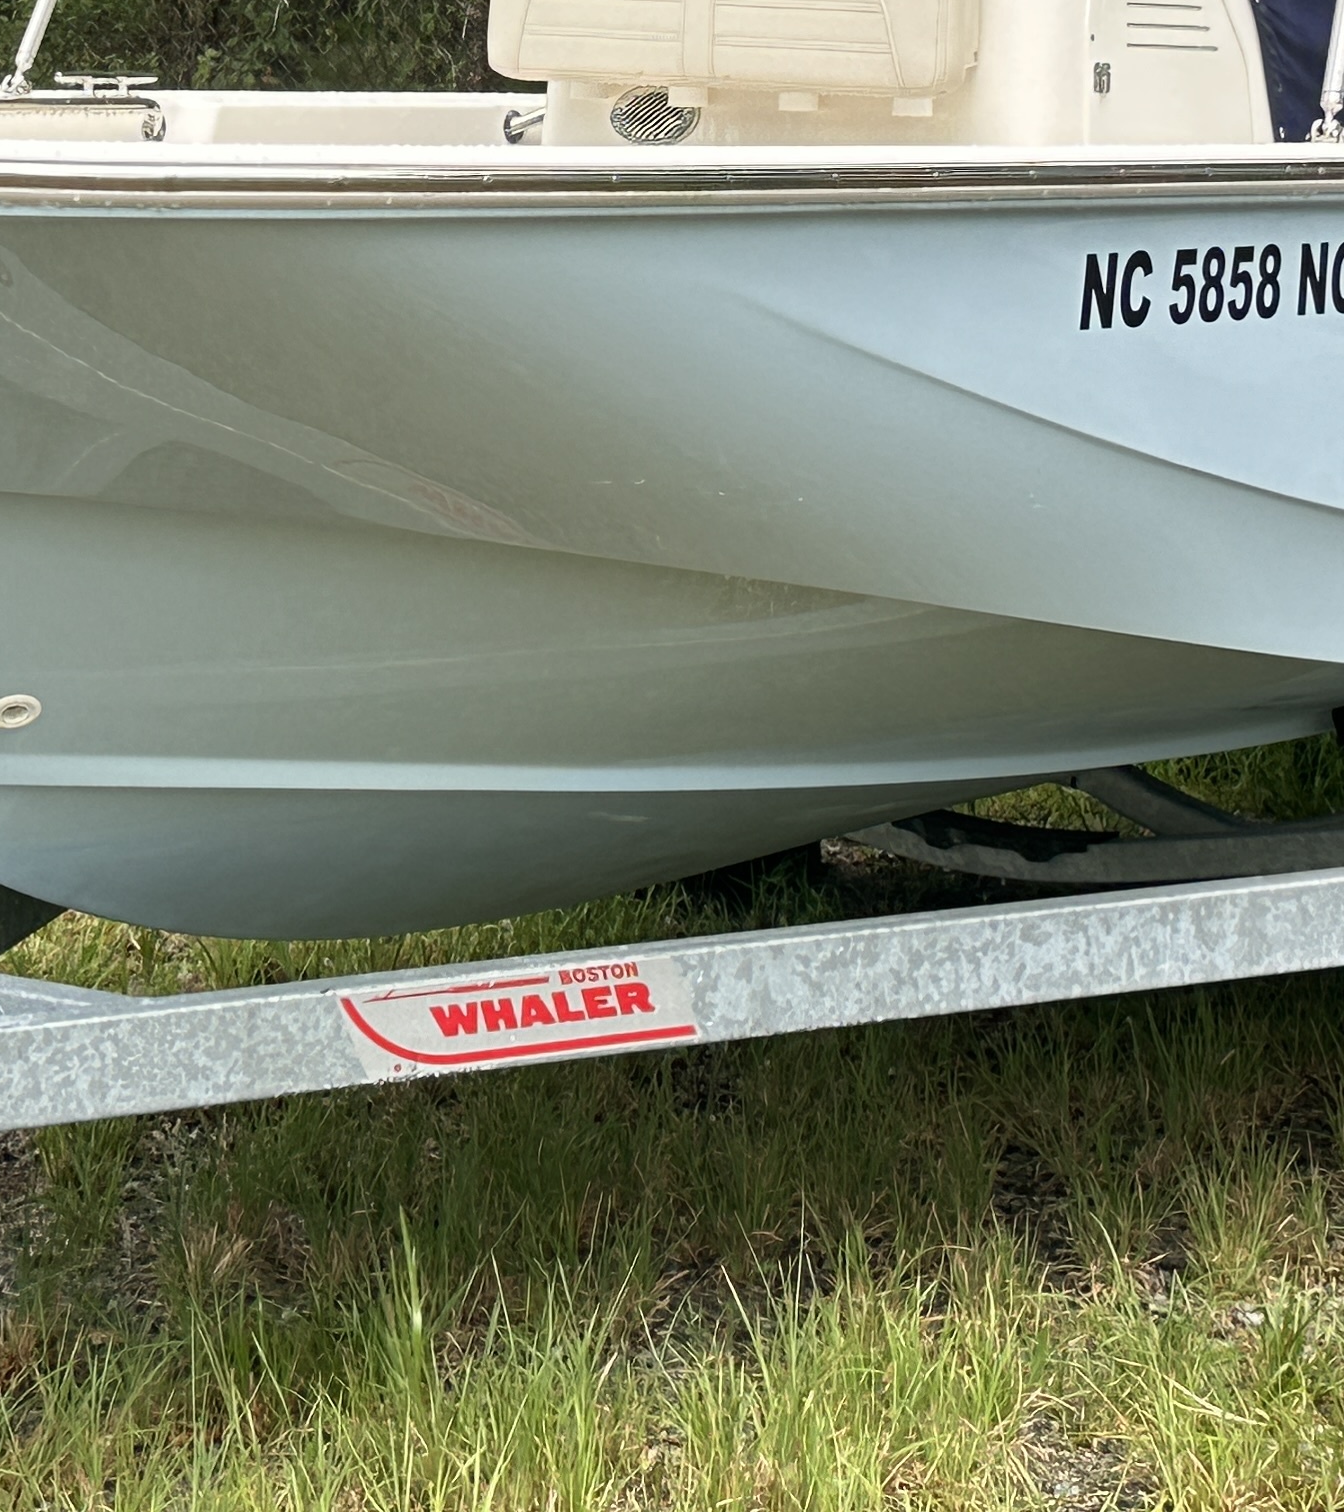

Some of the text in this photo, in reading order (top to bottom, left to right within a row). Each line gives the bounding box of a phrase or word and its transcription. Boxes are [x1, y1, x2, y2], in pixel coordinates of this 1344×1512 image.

[1079, 249, 1154, 331] NC
[1169, 243, 1282, 325] 5858
[560, 961, 639, 985] BOSTON
[429, 982, 656, 1038] WHALER
